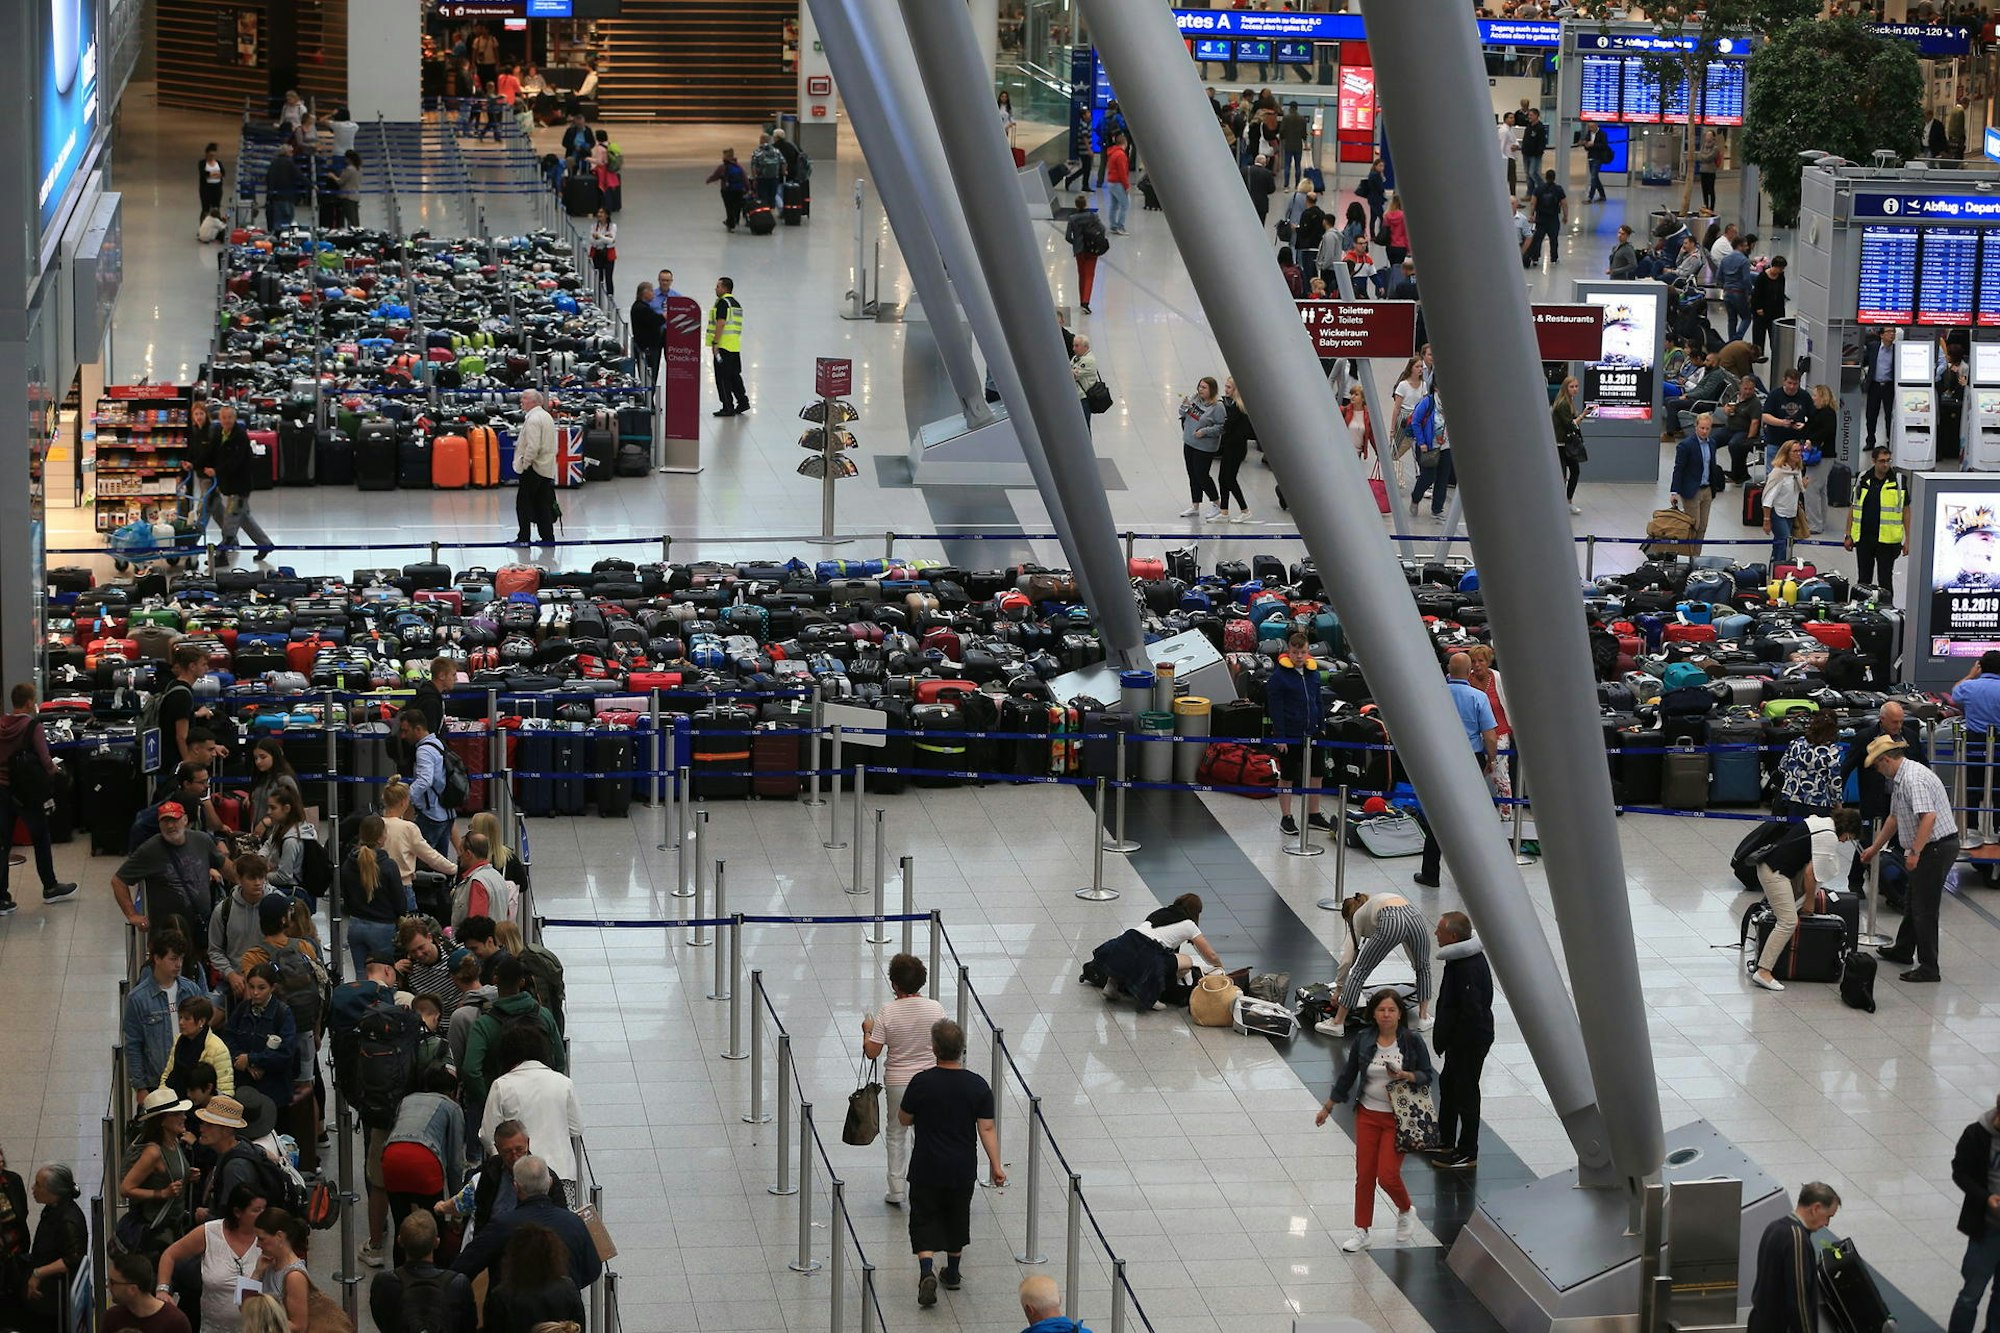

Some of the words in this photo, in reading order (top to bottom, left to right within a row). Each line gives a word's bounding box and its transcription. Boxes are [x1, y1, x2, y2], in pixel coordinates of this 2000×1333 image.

[1174, 14, 1214, 29] ates
[1216, 14, 1230, 29] A
[1240, 16, 1264, 24] Zugang
[1491, 24, 1514, 33] Zugang
[1516, 25, 1530, 33] auch
[1624, 38, 1650, 49] Abflug
[1923, 201, 1959, 214] Abflug
[1546, 315, 1594, 323] Restaurants
[1320, 339, 1340, 348] Baby
[668, 346, 694, 354] Priority-
[1600, 374, 1637, 384] 9.8.2019
[1841, 410, 1851, 462] Eurowings
[1952, 598, 1999, 612] 9.8.2019
